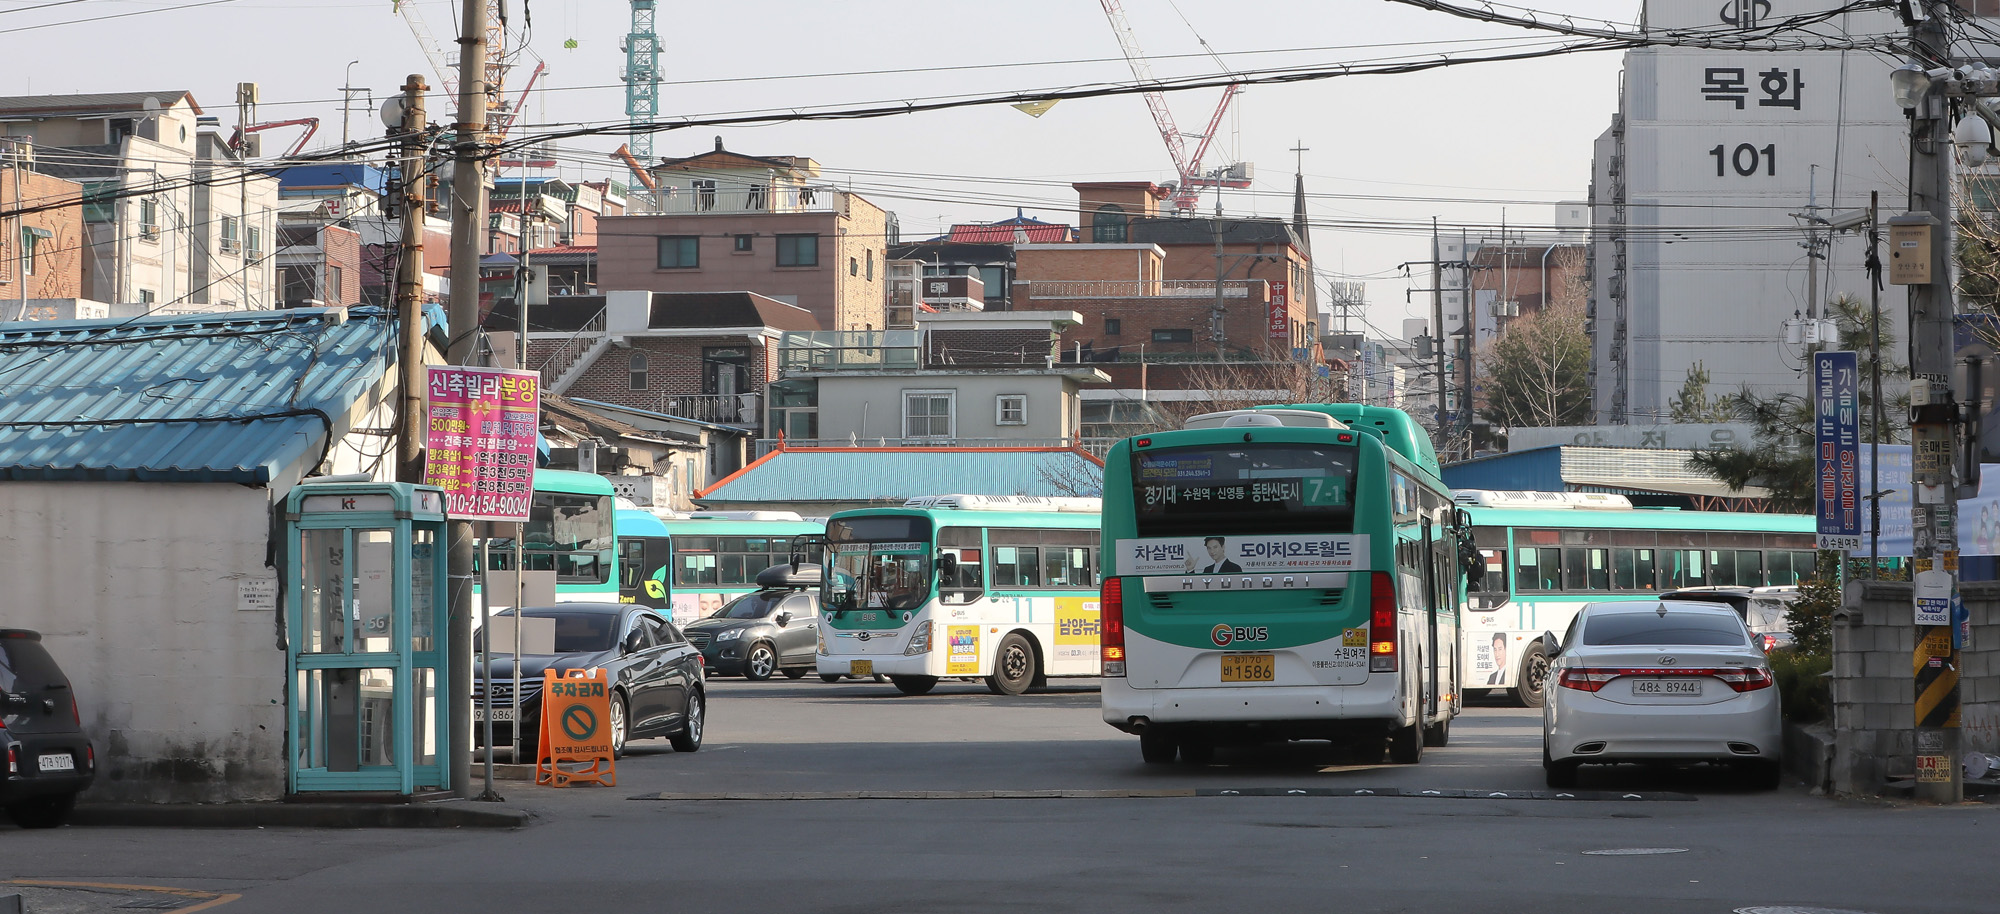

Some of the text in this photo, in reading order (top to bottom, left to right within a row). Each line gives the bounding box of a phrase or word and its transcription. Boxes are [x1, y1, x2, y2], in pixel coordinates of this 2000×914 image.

[1701, 68, 1805, 110] 목화
[1709, 143, 1775, 176] 101
[1271, 282, 1286, 330] 中国食品
[444, 435, 517, 450] 건축주 직접분양
[1820, 359, 1835, 519] 얼굴에는 미소를!!
[429, 448, 462, 462] 방2욕실1
[1838, 368, 1855, 530] 가슴에는 안전을!!
[428, 463, 461, 476] 방3욕실1
[1163, 468, 1177, 477] 모집
[1145, 479, 1340, 504] 경기대 수원역 신영통 동탄신도시 7-1
[341, 498, 355, 510] kt
[446, 493, 528, 515] 010-2154-9004
[1830, 538, 1859, 549] 수원여객
[1135, 541, 1352, 561] 차살땐 도이치오토월드
[1182, 575, 1310, 589] HYUNDAI
[620, 595, 636, 604] Zero!
[862, 613, 877, 621] BUS
[1013, 597, 1032, 623] 11
[1516, 601, 1536, 630] 11
[368, 617, 385, 629] 5G
[1334, 648, 1366, 660] 수원여객
[856, 666, 871, 674] 2512
[1224, 665, 1272, 679] 바 1586
[551, 682, 604, 697] 주차금지
[1639, 682, 1695, 692] 48소 8944
[555, 745, 609, 754] 협조에 감사드립니다
[54, 756, 70, 768] 9217
